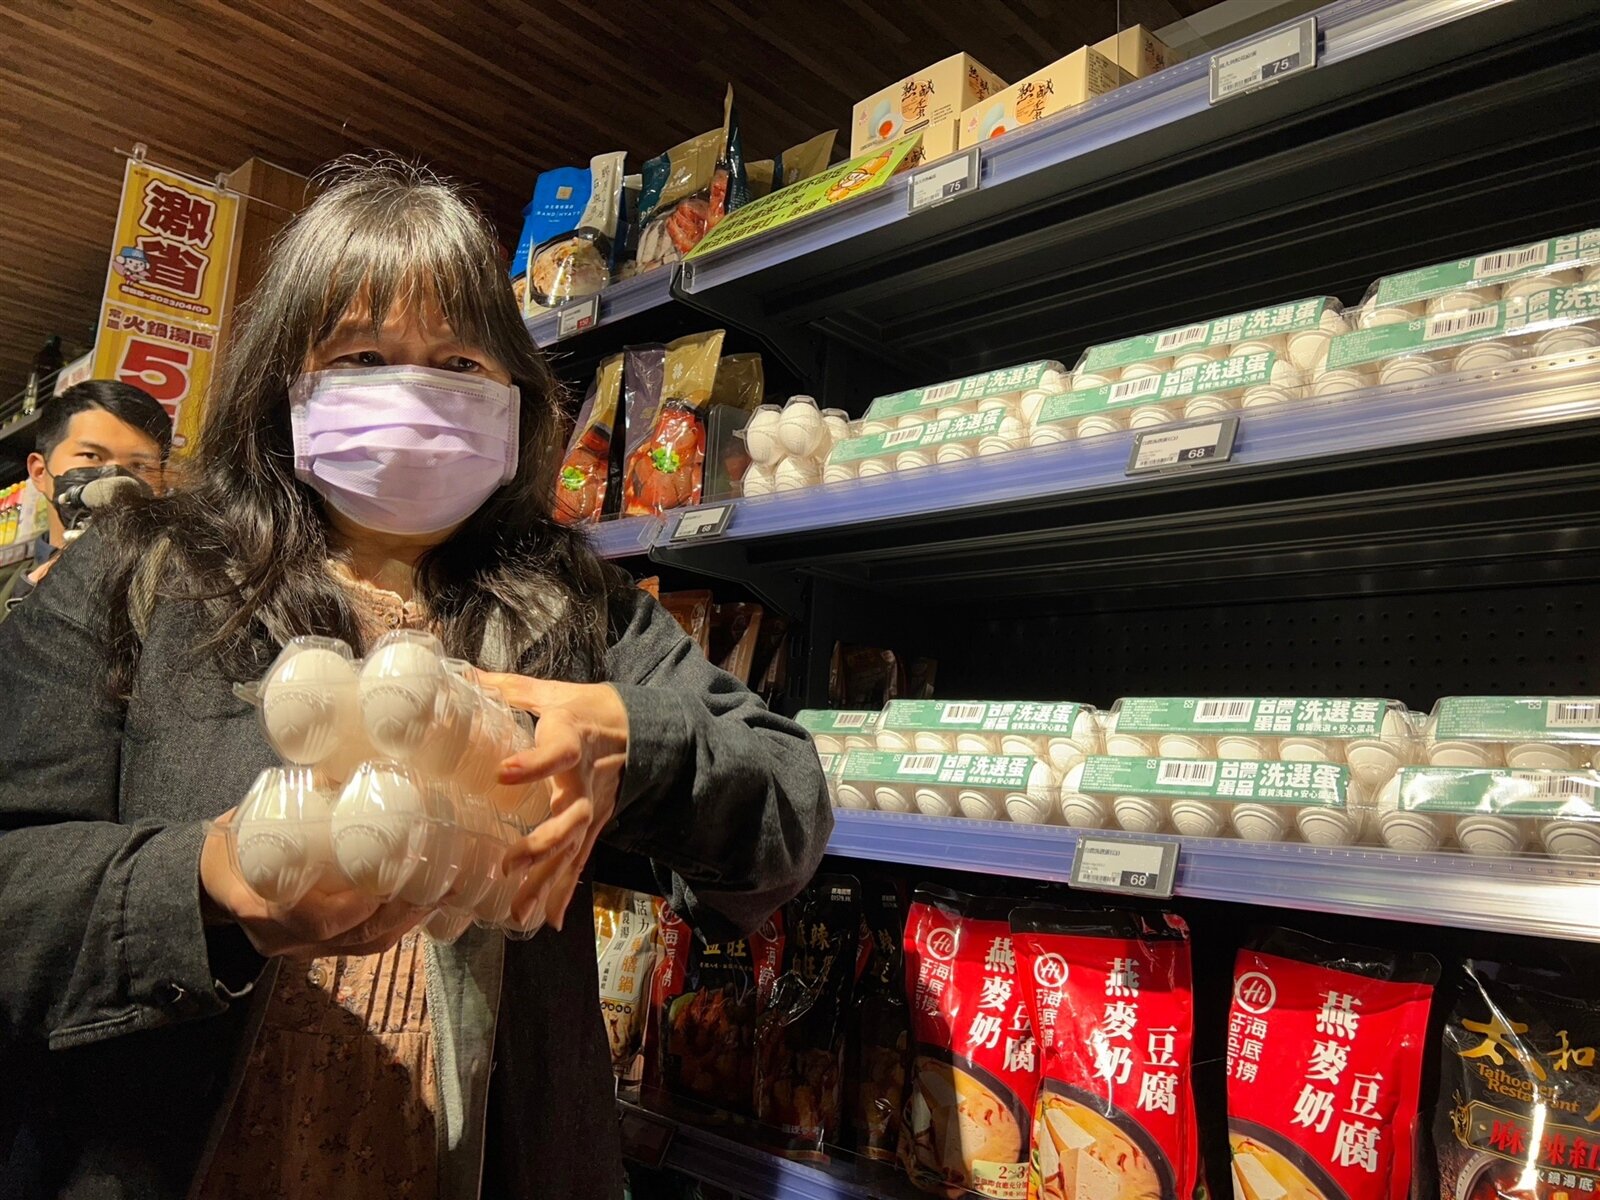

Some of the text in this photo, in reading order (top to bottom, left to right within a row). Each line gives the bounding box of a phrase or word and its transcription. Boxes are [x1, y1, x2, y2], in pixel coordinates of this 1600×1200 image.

[1272, 58, 1289, 74] 75
[950, 181, 961, 193] 75
[143, 184, 212, 296] 激省
[1246, 300, 1319, 329] 洗選蛋
[123, 315, 213, 349] 火鍋湯底
[987, 364, 1043, 387] 洗選蛋
[1198, 353, 1270, 382] 洗選蛋
[948, 408, 1002, 432] 洗選蛋
[1188, 449, 1206, 459] 68
[1013, 704, 1074, 723] 洗選蛋
[1297, 700, 1379, 723] 洗選蛋
[969, 756, 1029, 777] 洗選蛋
[1259, 763, 1341, 789] 洗選蛋
[1130, 874, 1147, 886] 68
[921, 961, 950, 1013] 海底撈
[967, 937, 1016, 1050] 燕麥奶
[1092, 957, 1140, 1086] 燕麥奶
[1002, 1002, 1036, 1073] 豆腐
[1226, 1011, 1247, 1076] Haidilao
[1235, 1017, 1269, 1083] 海底撈
[1136, 1025, 1180, 1116] 豆腐
[1289, 990, 1364, 1134] 燕麥奶
[1330, 1071, 1384, 1174] 豆腐
